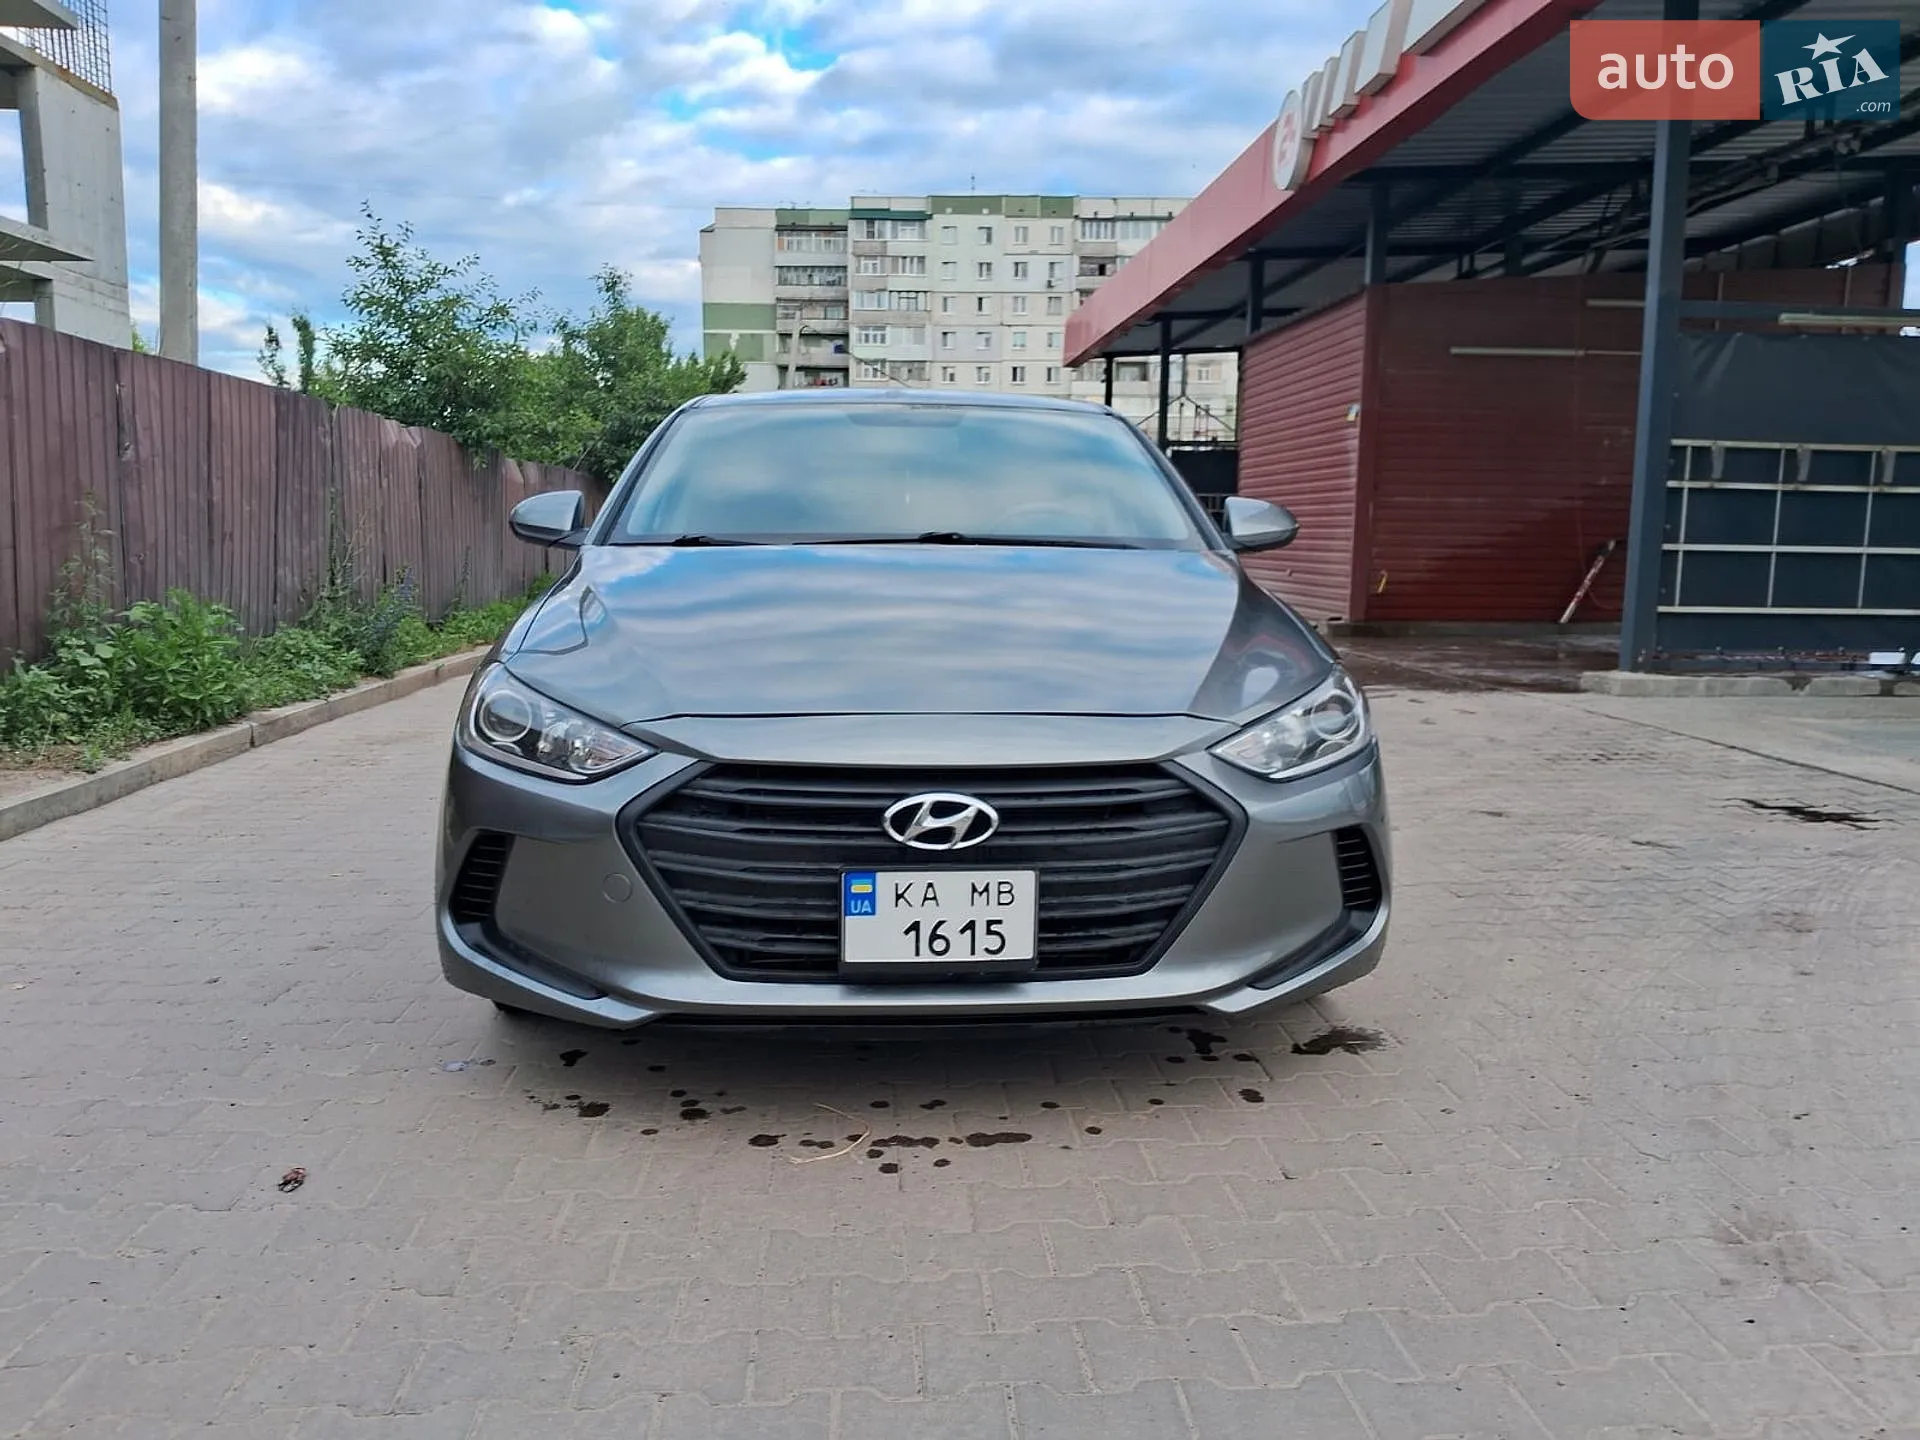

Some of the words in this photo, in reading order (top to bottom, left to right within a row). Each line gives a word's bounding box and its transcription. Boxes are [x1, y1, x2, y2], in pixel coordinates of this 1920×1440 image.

[850, 900, 872, 914] UA
[894, 882, 940, 908] KA
[970, 881, 1015, 907] MB
[903, 919, 1007, 957] 1615
